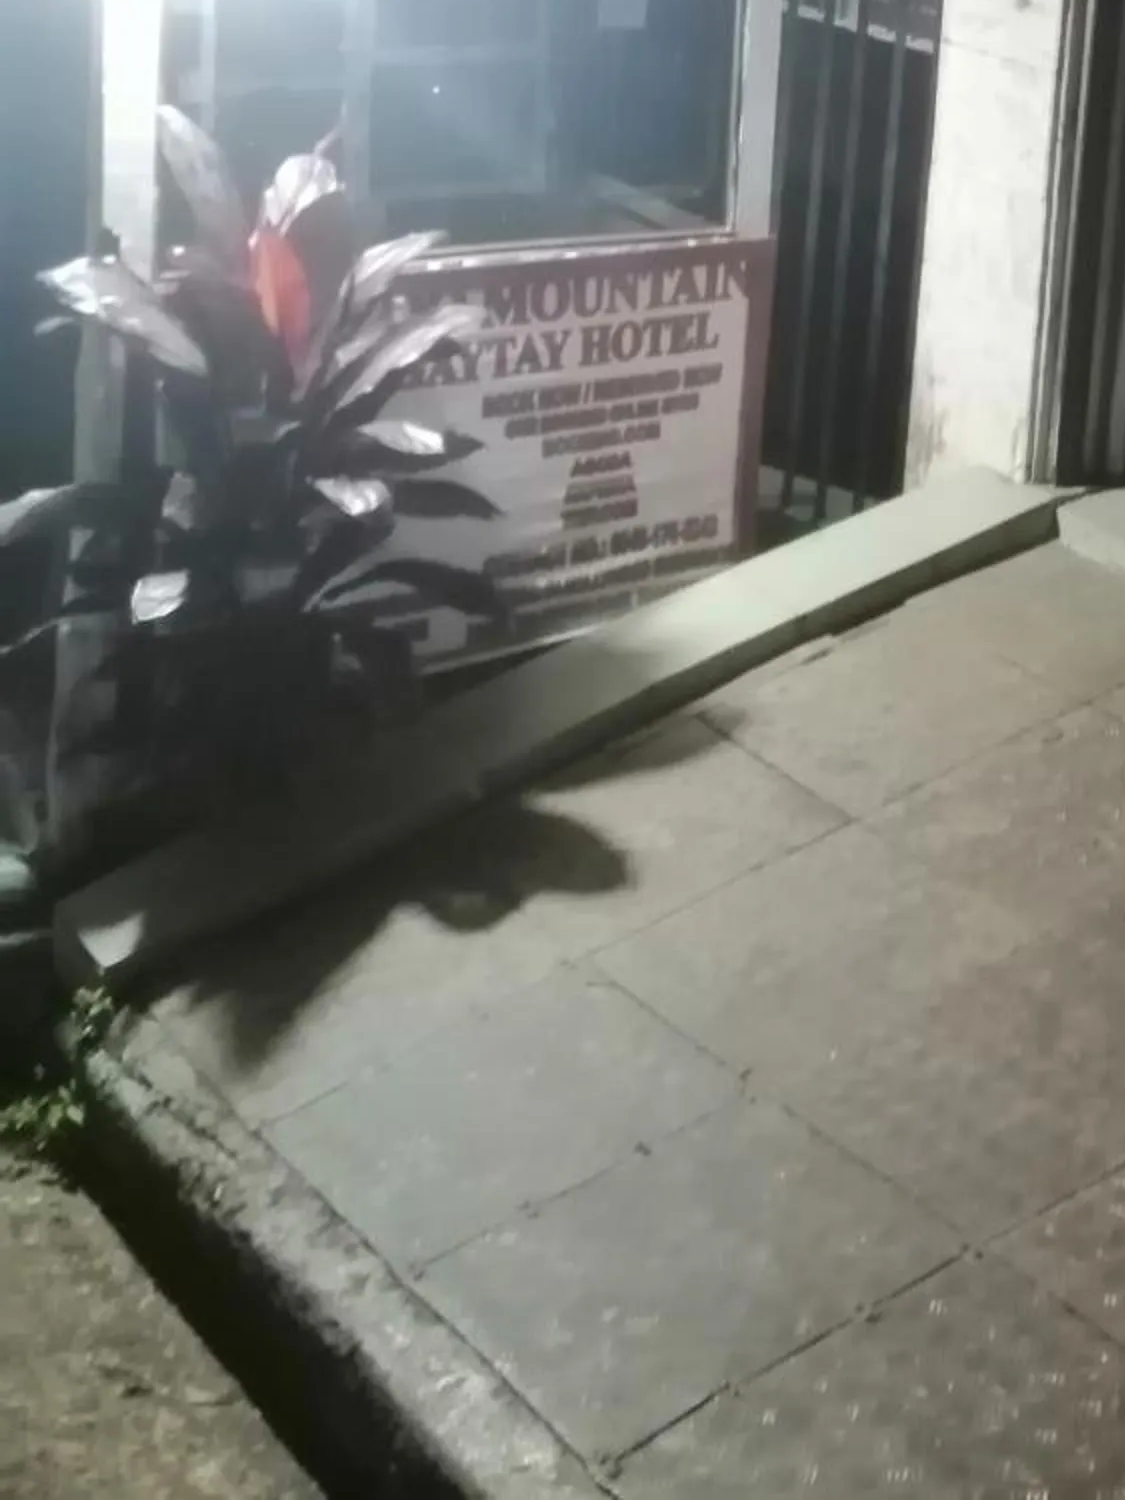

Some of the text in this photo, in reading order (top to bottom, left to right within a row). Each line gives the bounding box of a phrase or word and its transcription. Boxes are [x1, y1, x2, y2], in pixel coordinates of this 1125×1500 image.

[482, 259, 752, 329] MOUNTAIN
[415, 310, 720, 387] AYTAY HOTEL
